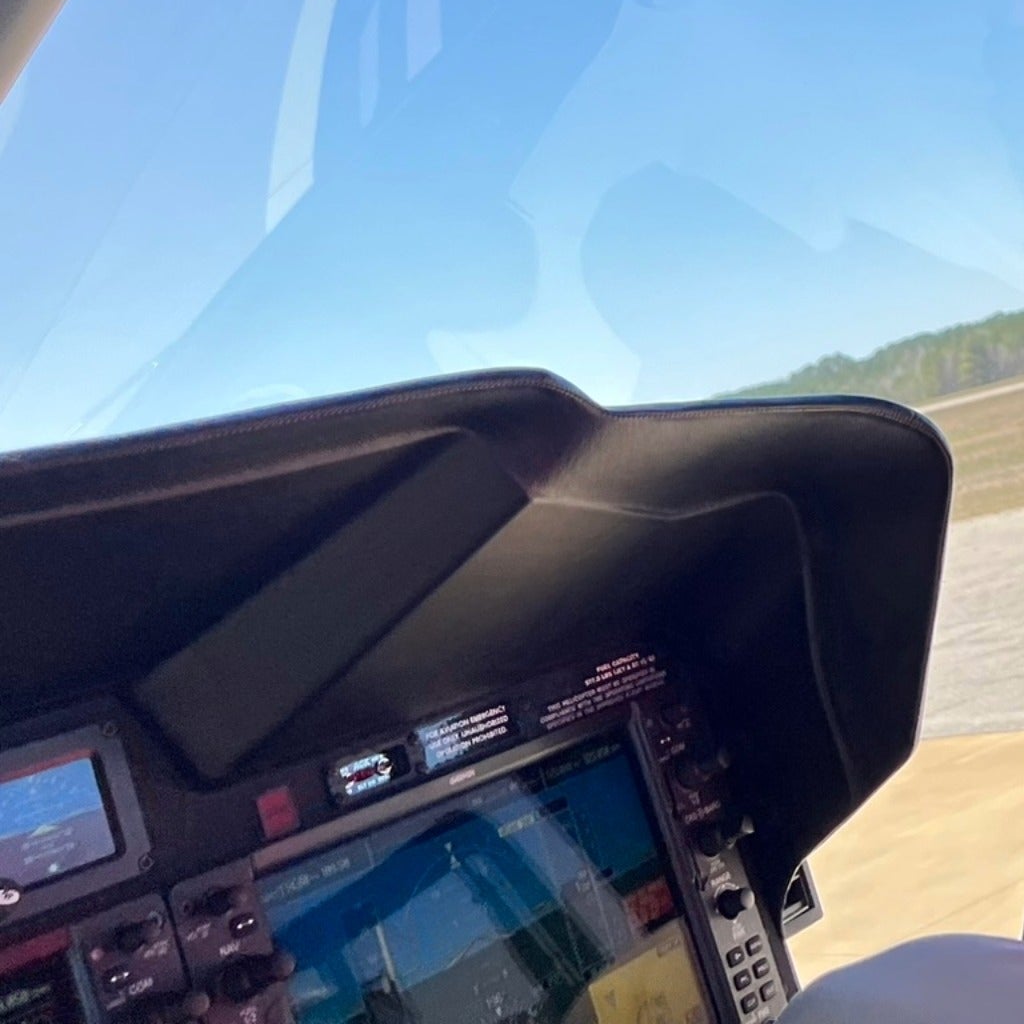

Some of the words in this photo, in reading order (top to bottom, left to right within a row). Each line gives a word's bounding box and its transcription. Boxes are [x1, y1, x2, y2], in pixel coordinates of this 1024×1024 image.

[438, 718, 469, 735] AVIATION
[469, 704, 506, 723] EMERGENCY
[460, 714, 509, 738] UNAUTHORIZED
